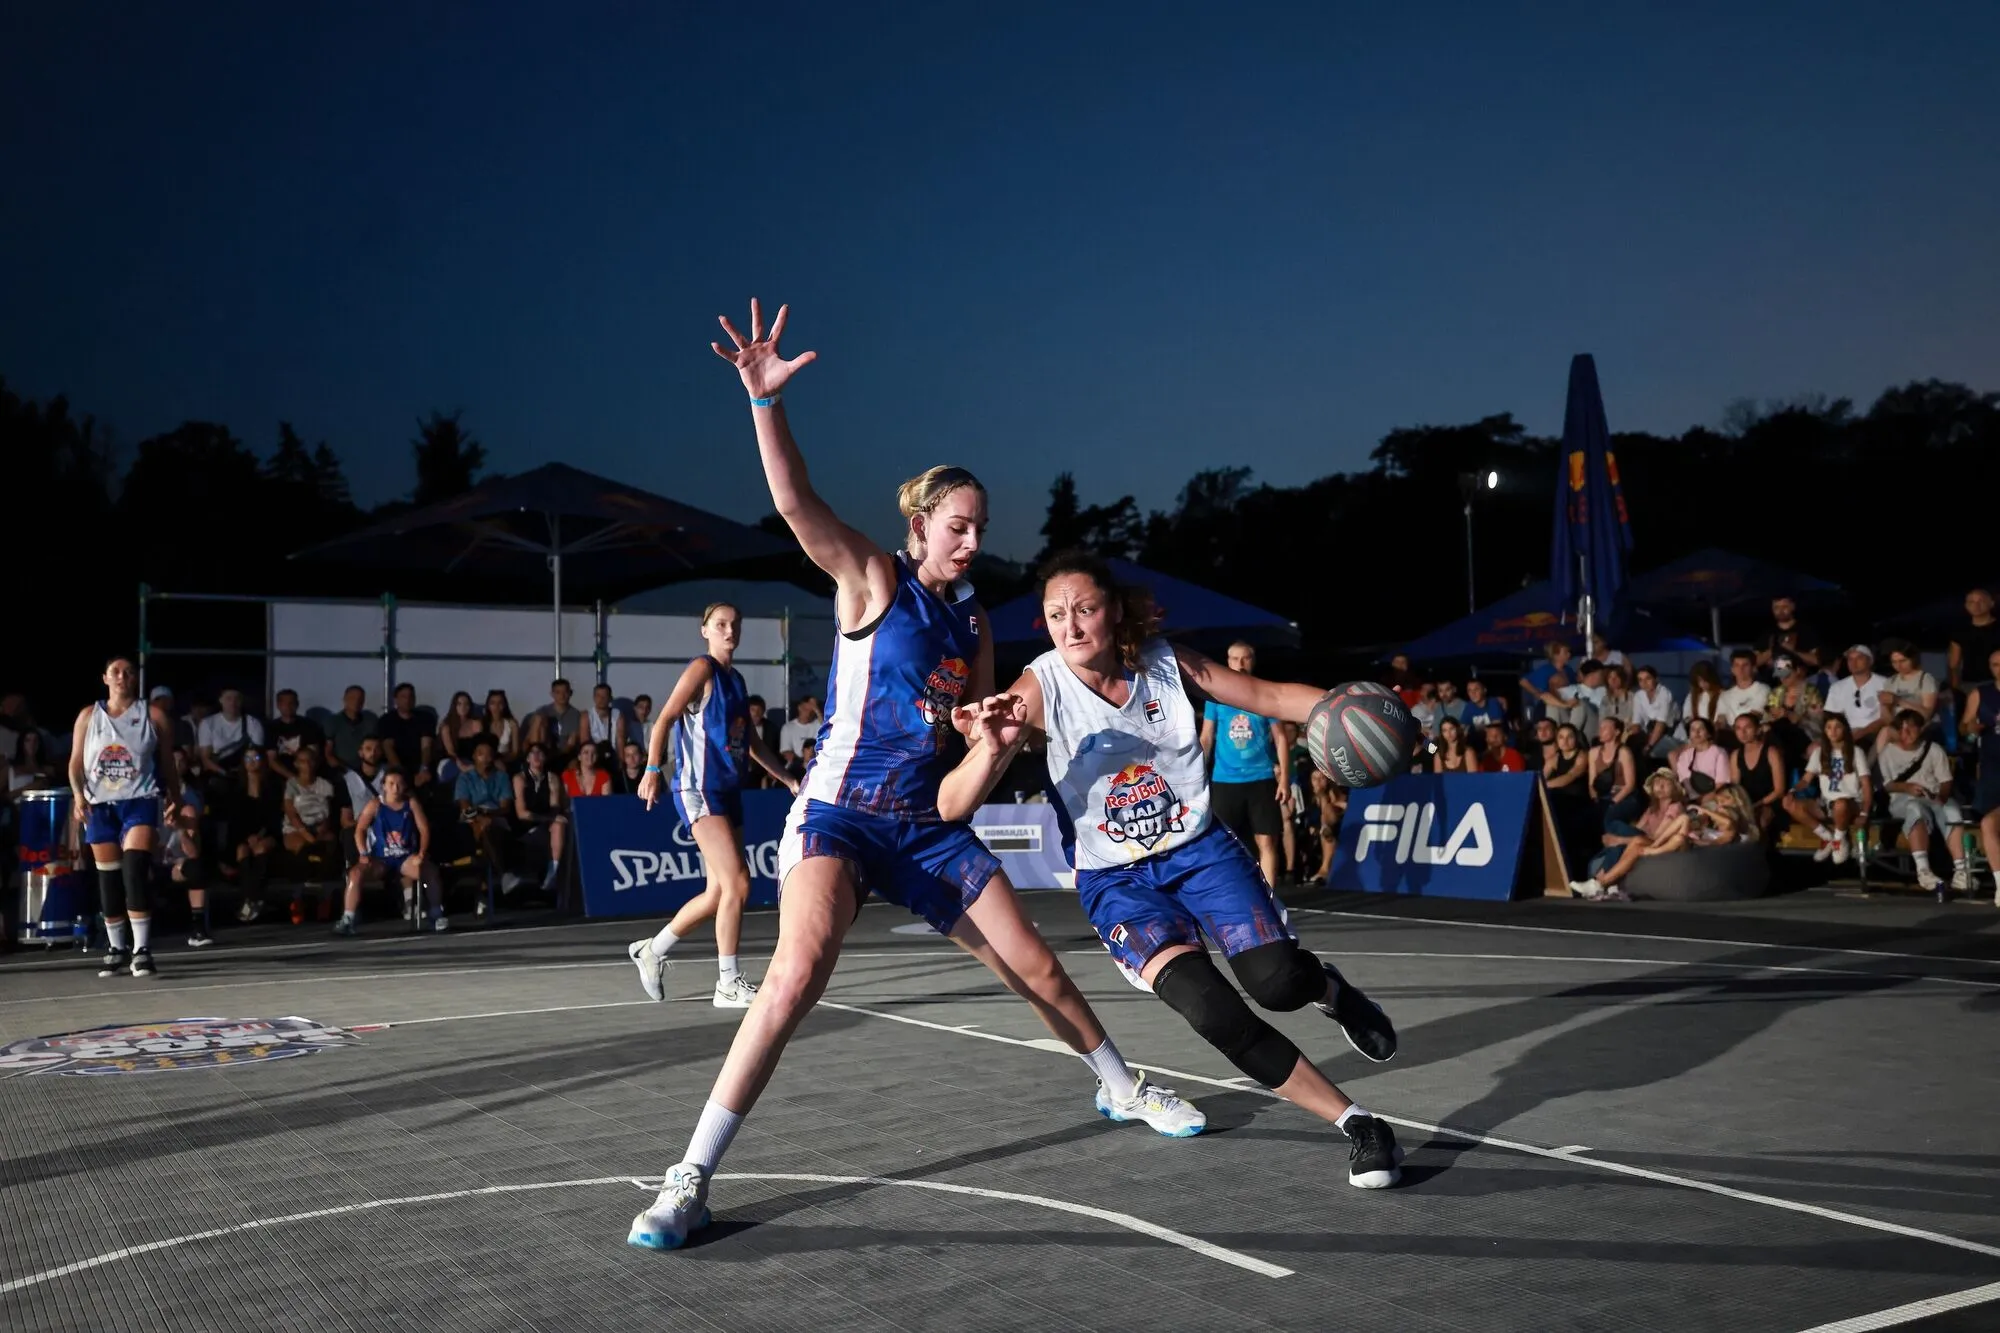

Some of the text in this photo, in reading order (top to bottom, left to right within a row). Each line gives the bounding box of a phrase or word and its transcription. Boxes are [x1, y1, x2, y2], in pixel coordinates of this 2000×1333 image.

[1105, 776, 1166, 808] Red Bull
[1122, 800, 1163, 822] HALF
[1355, 802, 1493, 867] FILA
[610, 840, 779, 891] SPALNG
